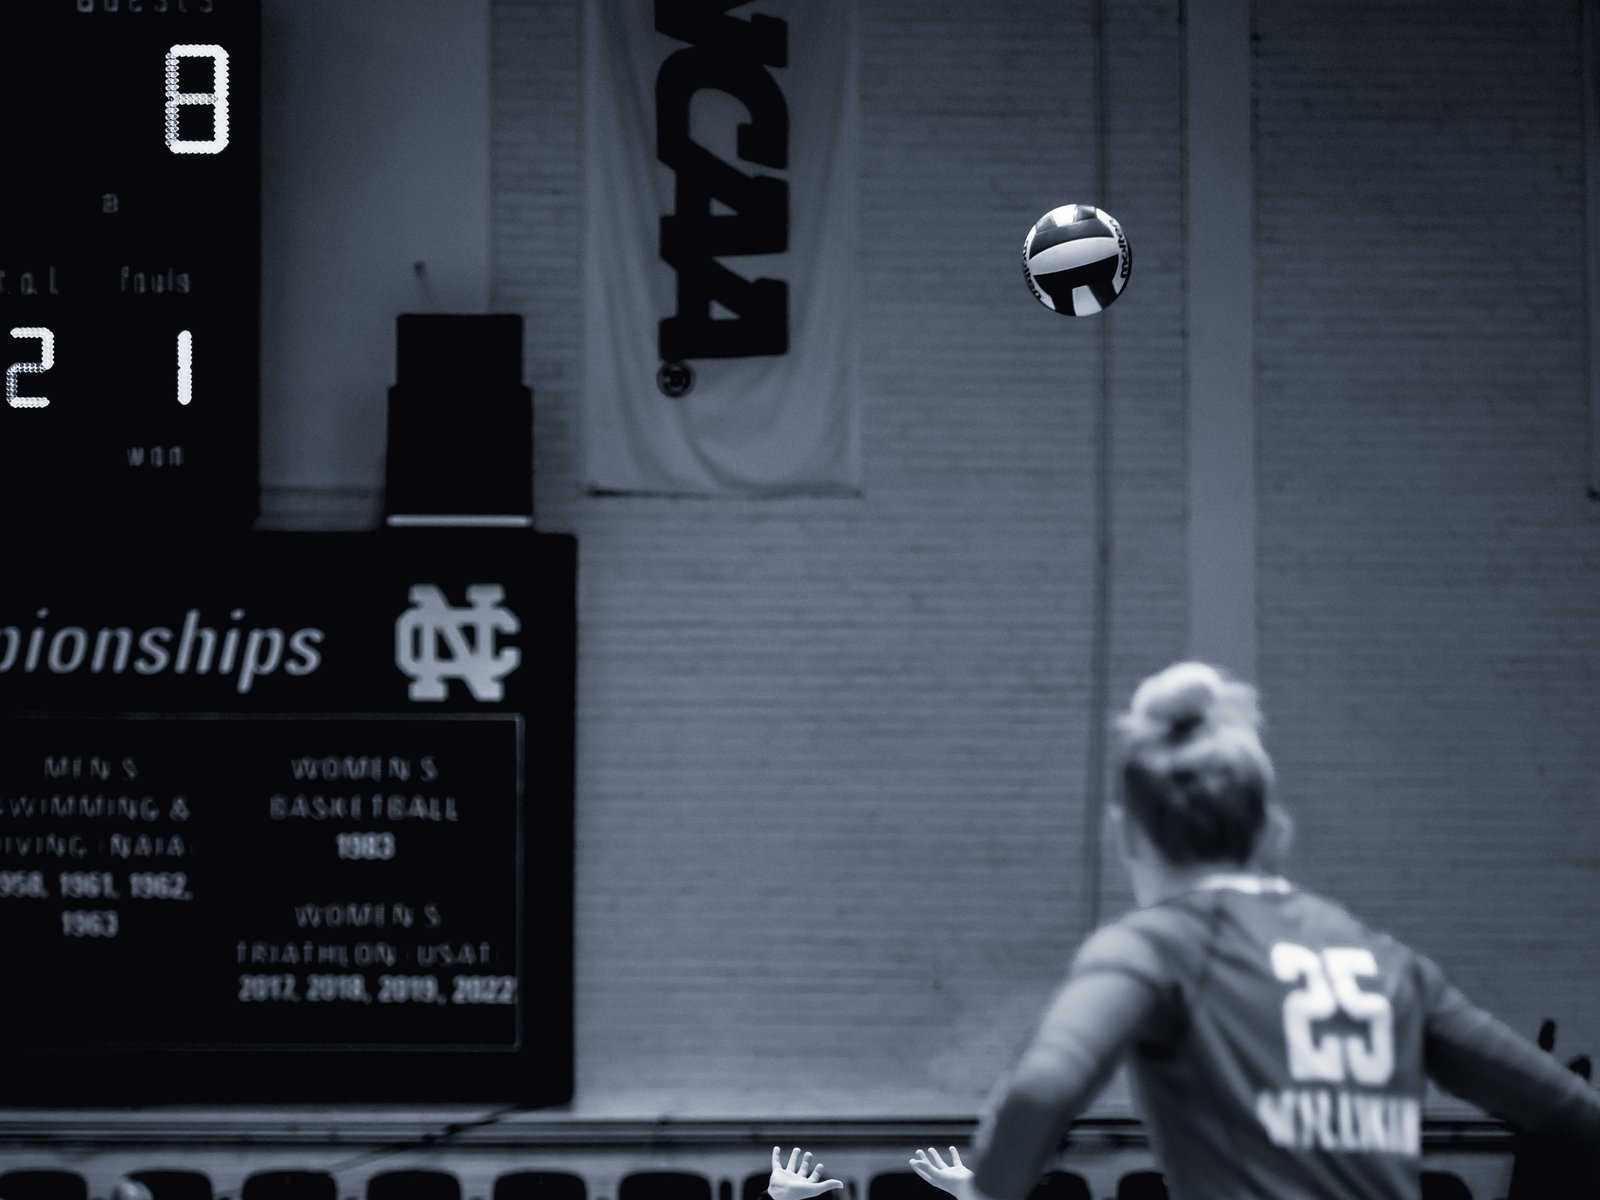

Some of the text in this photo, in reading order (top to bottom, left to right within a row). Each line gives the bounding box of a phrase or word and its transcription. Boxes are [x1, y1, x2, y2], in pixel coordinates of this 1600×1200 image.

[165, 44, 229, 154] 8
[6, 327, 54, 408] 2
[177, 330, 192, 405] 1
[0, 794, 160, 821] WIMMING
[269, 794, 460, 821] BASKETBALL
[0, 833, 88, 859] IVING
[236, 940, 396, 968] TRIATHLON
[1270, 941, 1396, 1087] 25
